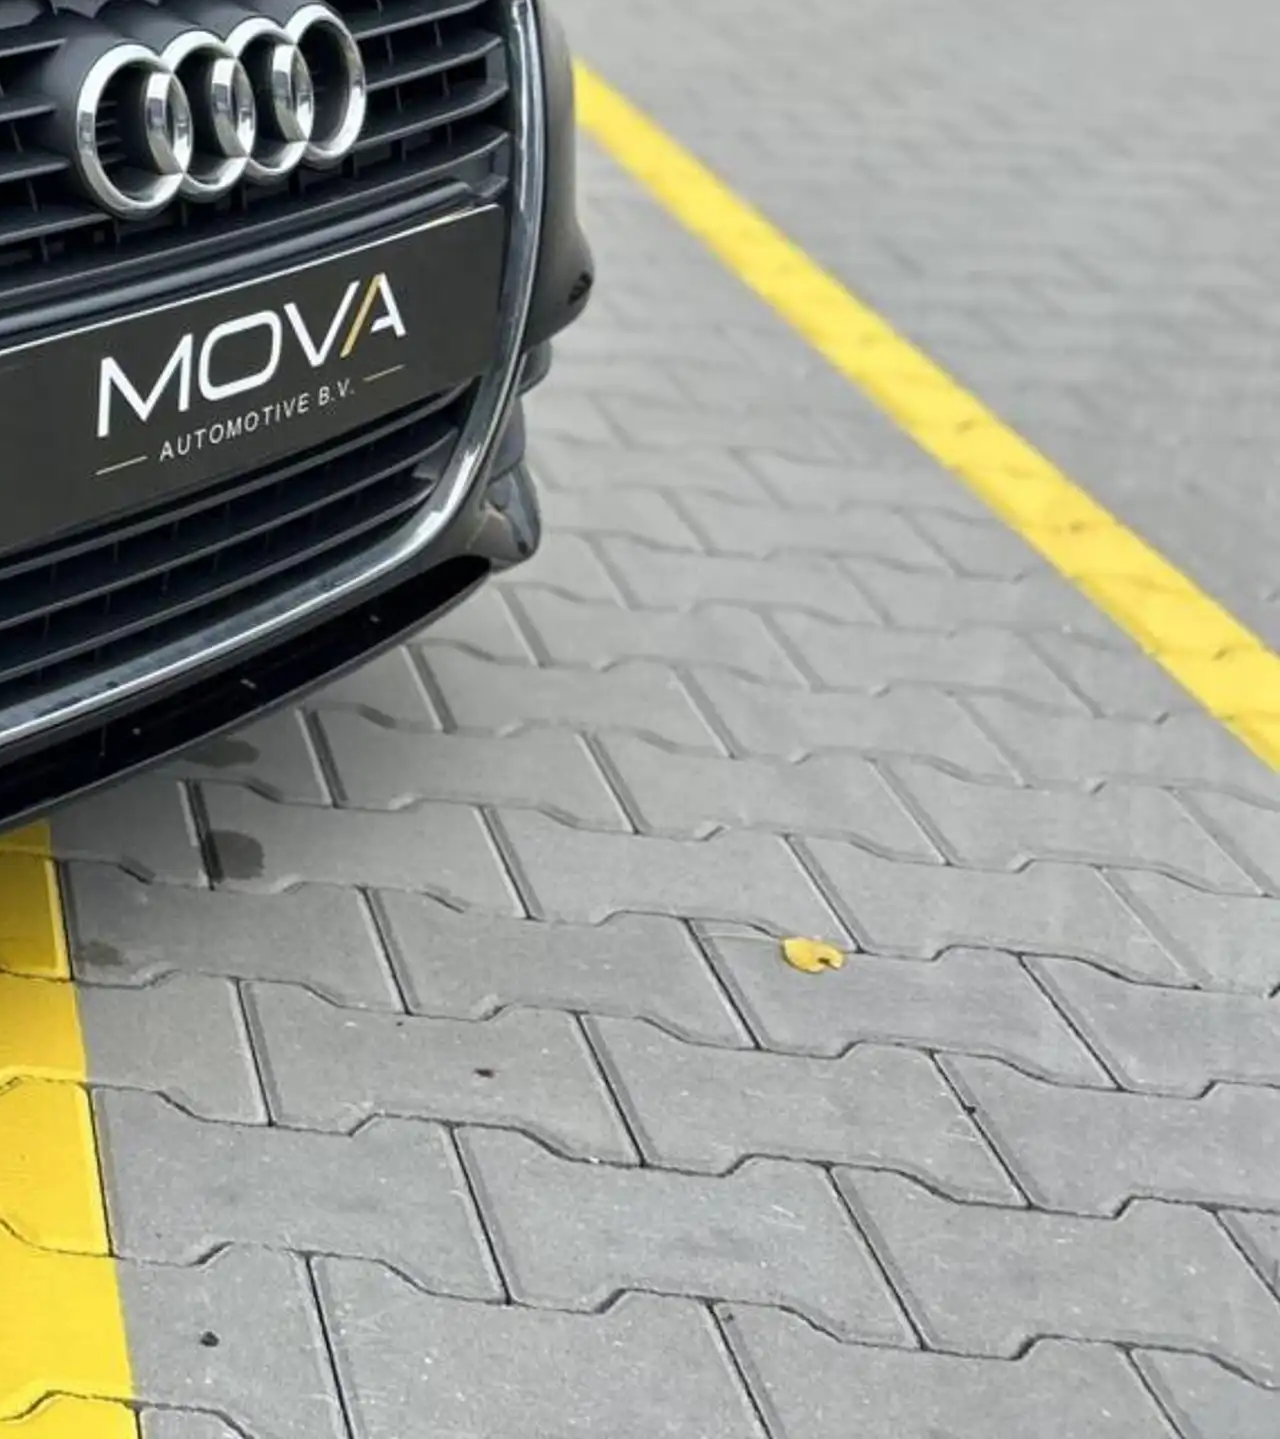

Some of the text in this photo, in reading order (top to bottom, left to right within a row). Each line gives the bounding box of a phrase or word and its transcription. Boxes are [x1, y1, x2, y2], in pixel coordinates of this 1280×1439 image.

[96, 272, 407, 438] MOVA
[158, 379, 355, 462] AUTOMOTIVE B.V.
